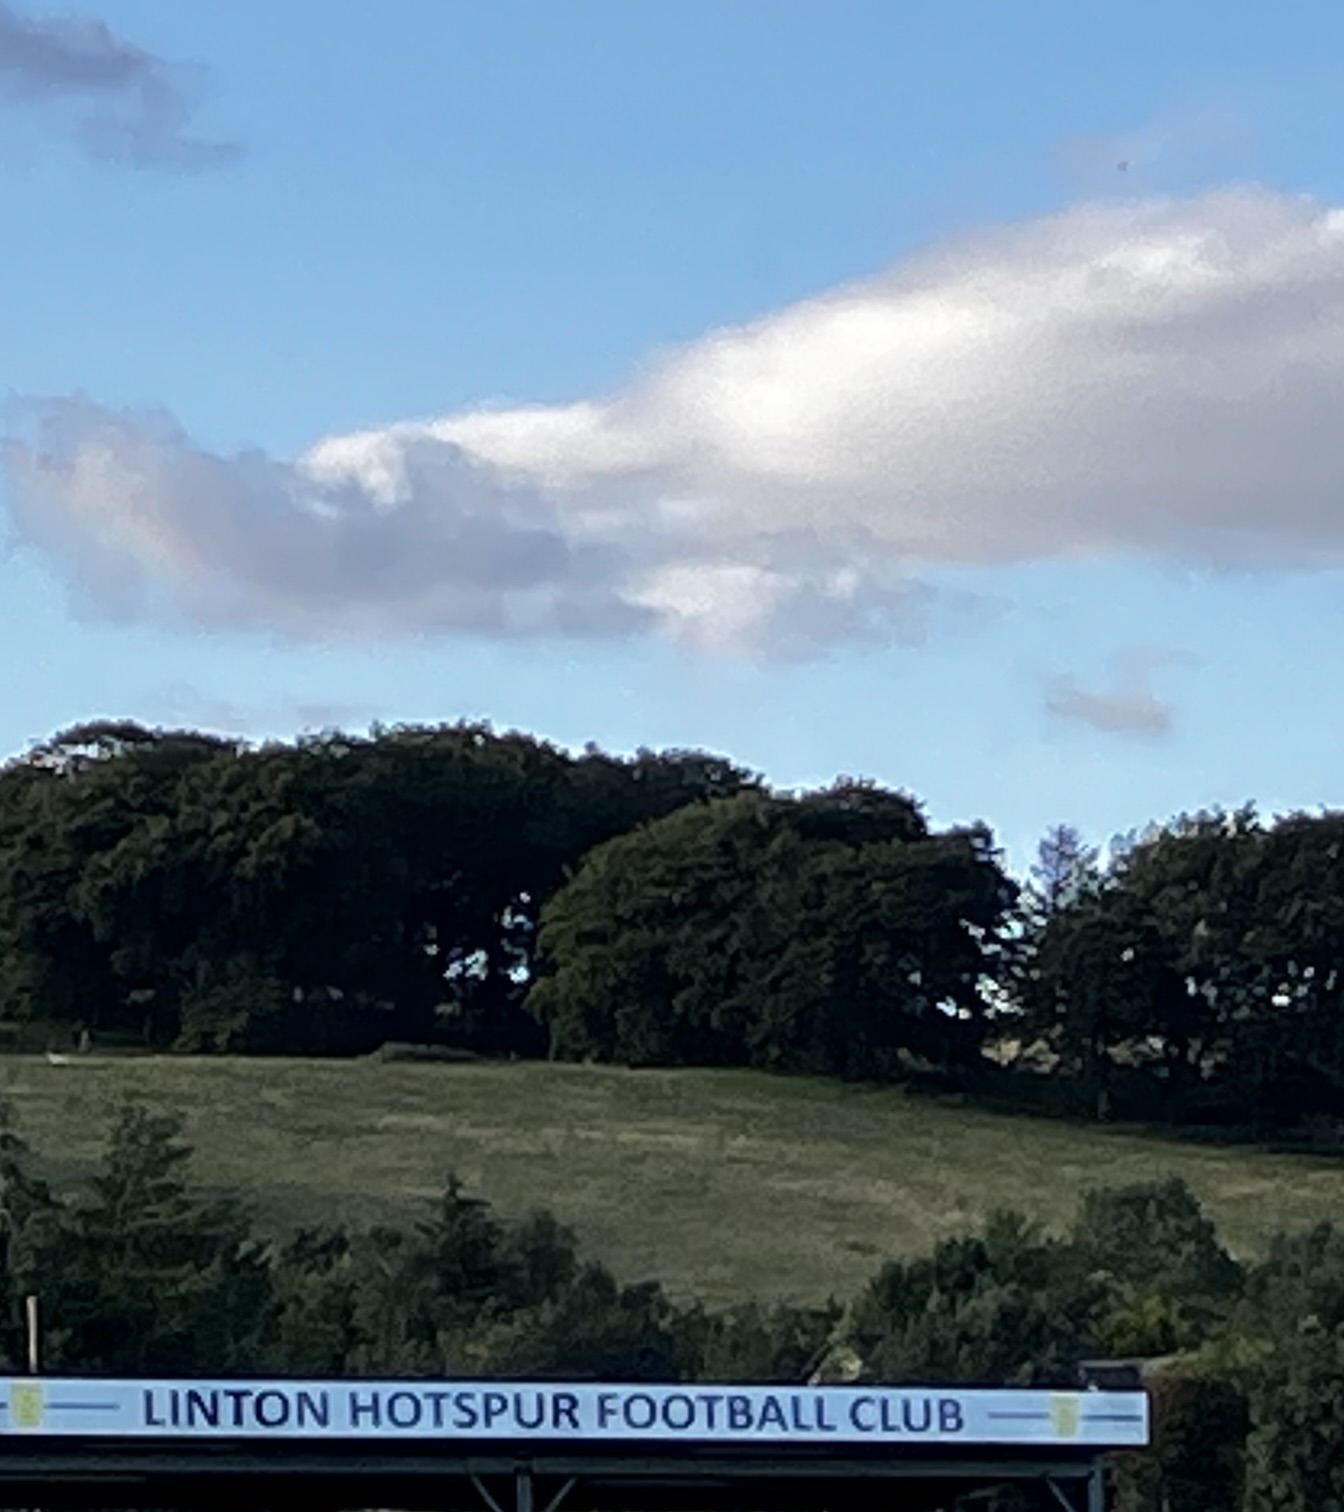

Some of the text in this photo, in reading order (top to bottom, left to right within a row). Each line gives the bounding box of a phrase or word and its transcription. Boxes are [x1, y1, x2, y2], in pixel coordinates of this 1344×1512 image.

[142, 1389, 964, 1434] LINTON HOTSPUR FOOTBALL CLUB
